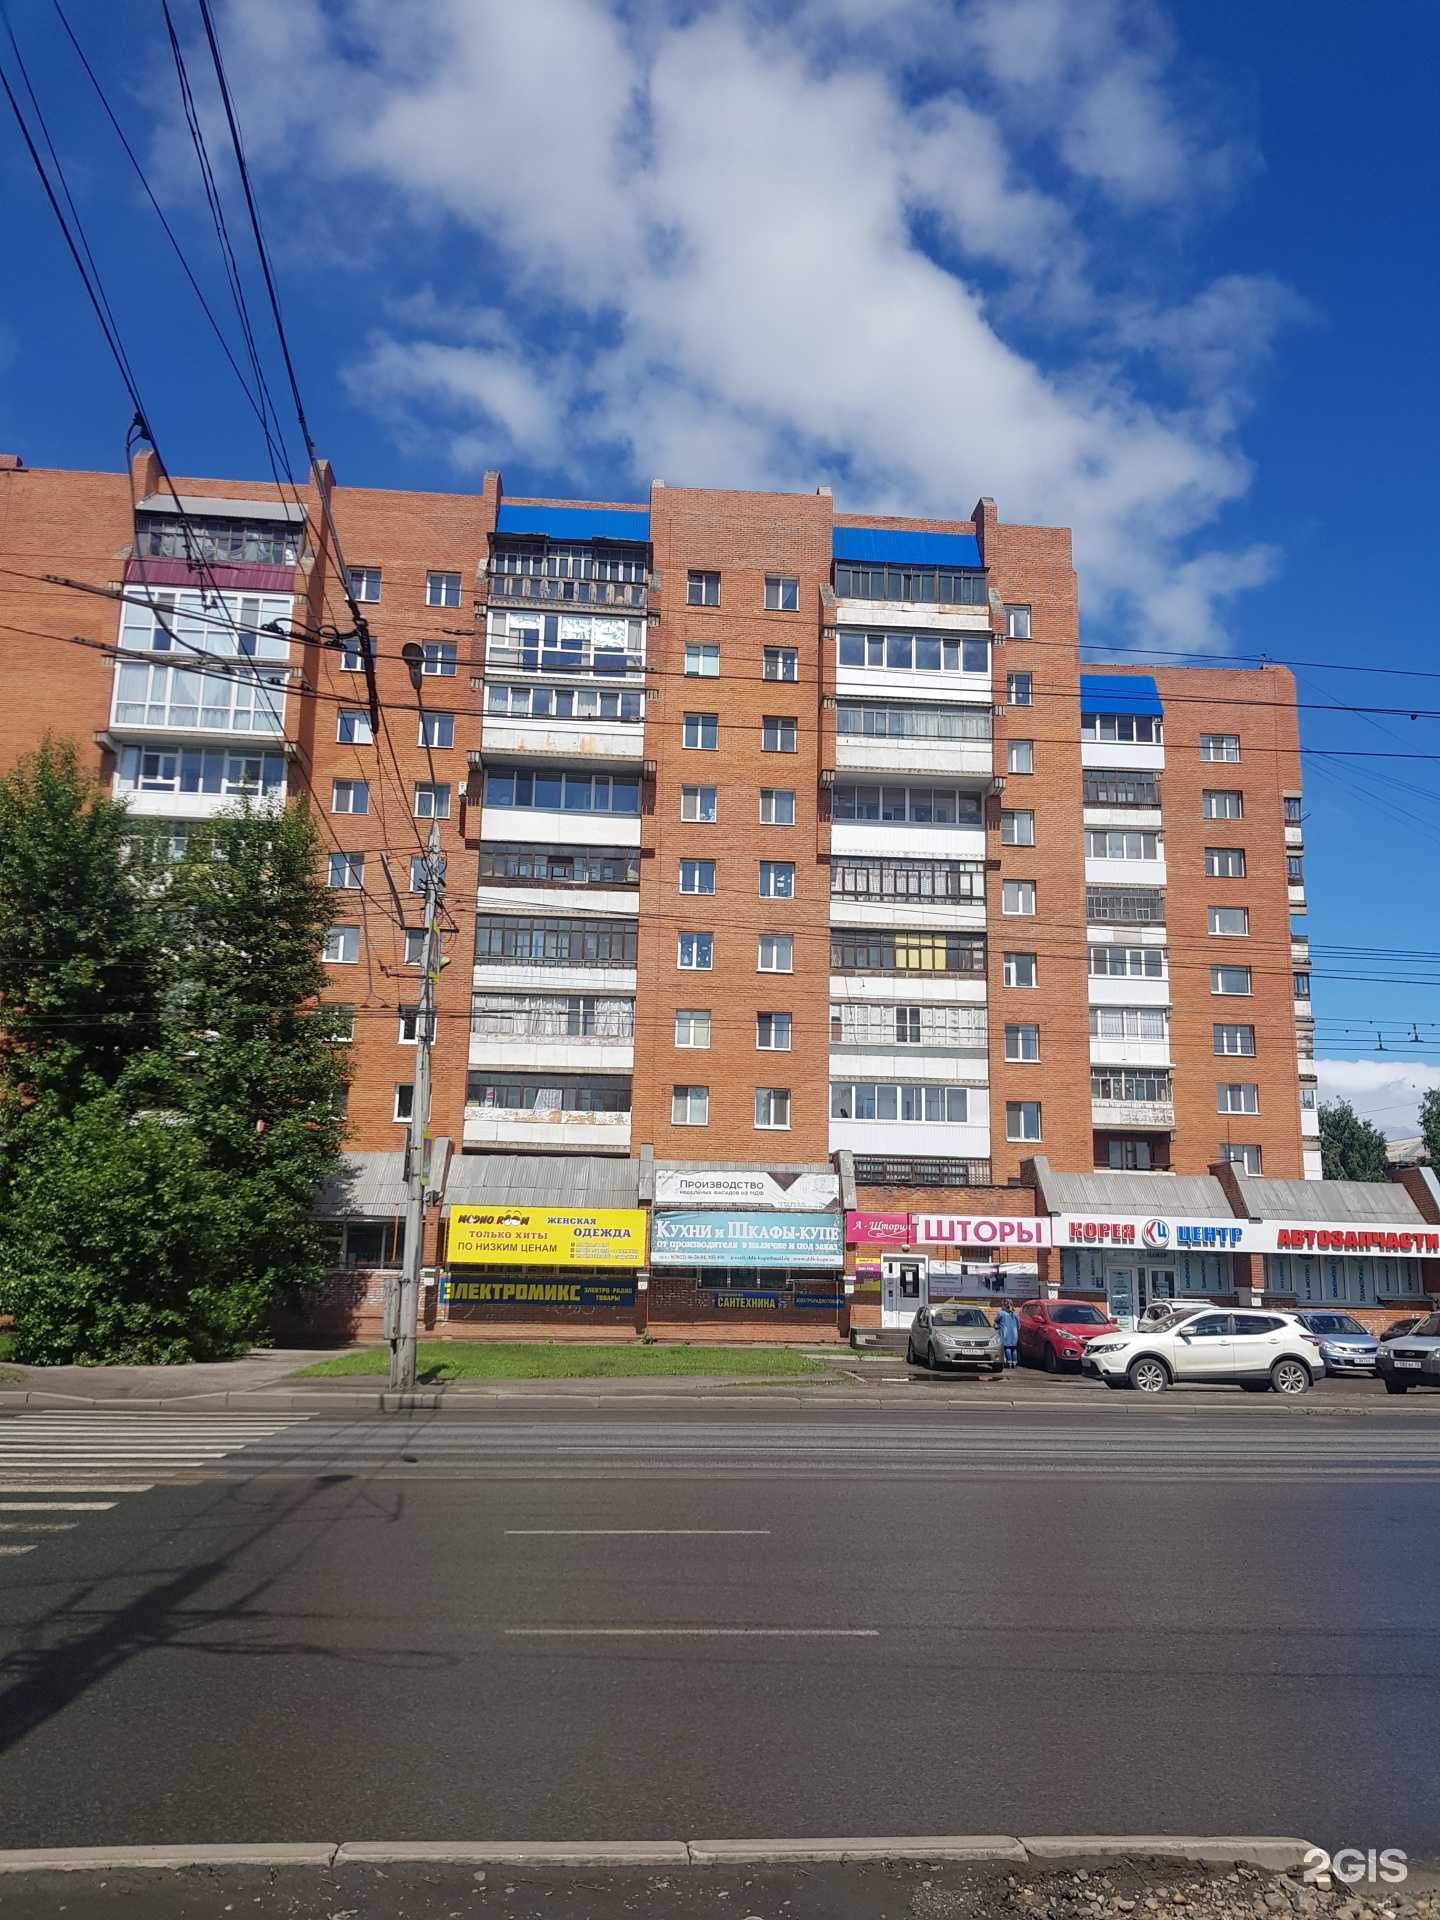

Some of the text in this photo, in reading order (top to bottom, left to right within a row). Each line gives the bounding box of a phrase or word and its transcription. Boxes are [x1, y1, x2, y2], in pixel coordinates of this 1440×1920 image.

[547, 1217, 597, 1225] ЖЕНСКАЯ
[469, 1230, 548, 1240] ТОЛЬКО ХИТЫ
[573, 1228, 631, 1238] ОДЕЖДА
[924, 1219, 1042, 1243] ШТОРЫ
[1069, 1222, 1136, 1242] КОРЕЯ
[1177, 1225, 1243, 1247] ЦЕНТР
[1277, 1229, 1440, 1252] АВТОЗАПЧАСТИ
[457, 1242, 557, 1253] ПО НИЗКИМ ЦЕНАМ
[444, 1282, 581, 1301] ЭЛЕКТРОМИКС
